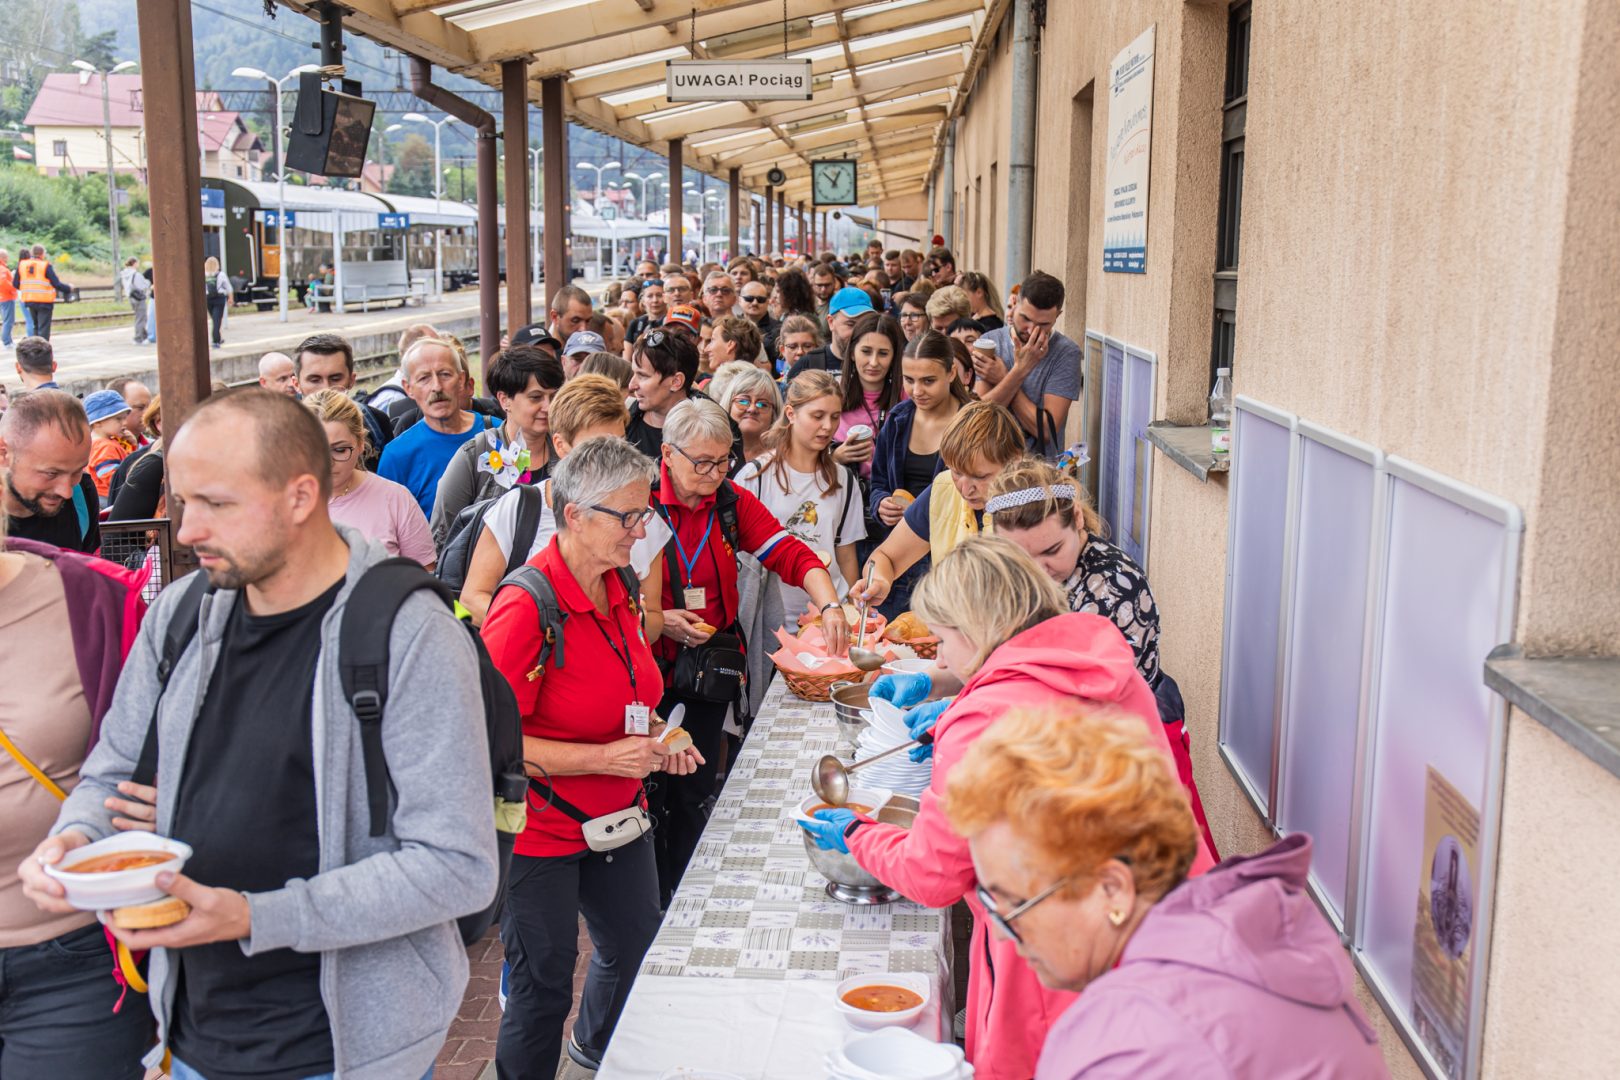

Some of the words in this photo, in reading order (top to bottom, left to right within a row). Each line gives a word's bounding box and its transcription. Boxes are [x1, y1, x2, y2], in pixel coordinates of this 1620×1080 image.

[675, 74, 743, 87] UWAGA!
[749, 74, 803, 88] Pociąg
[267, 214, 275, 225] 2
[399, 216, 406, 227] 1
